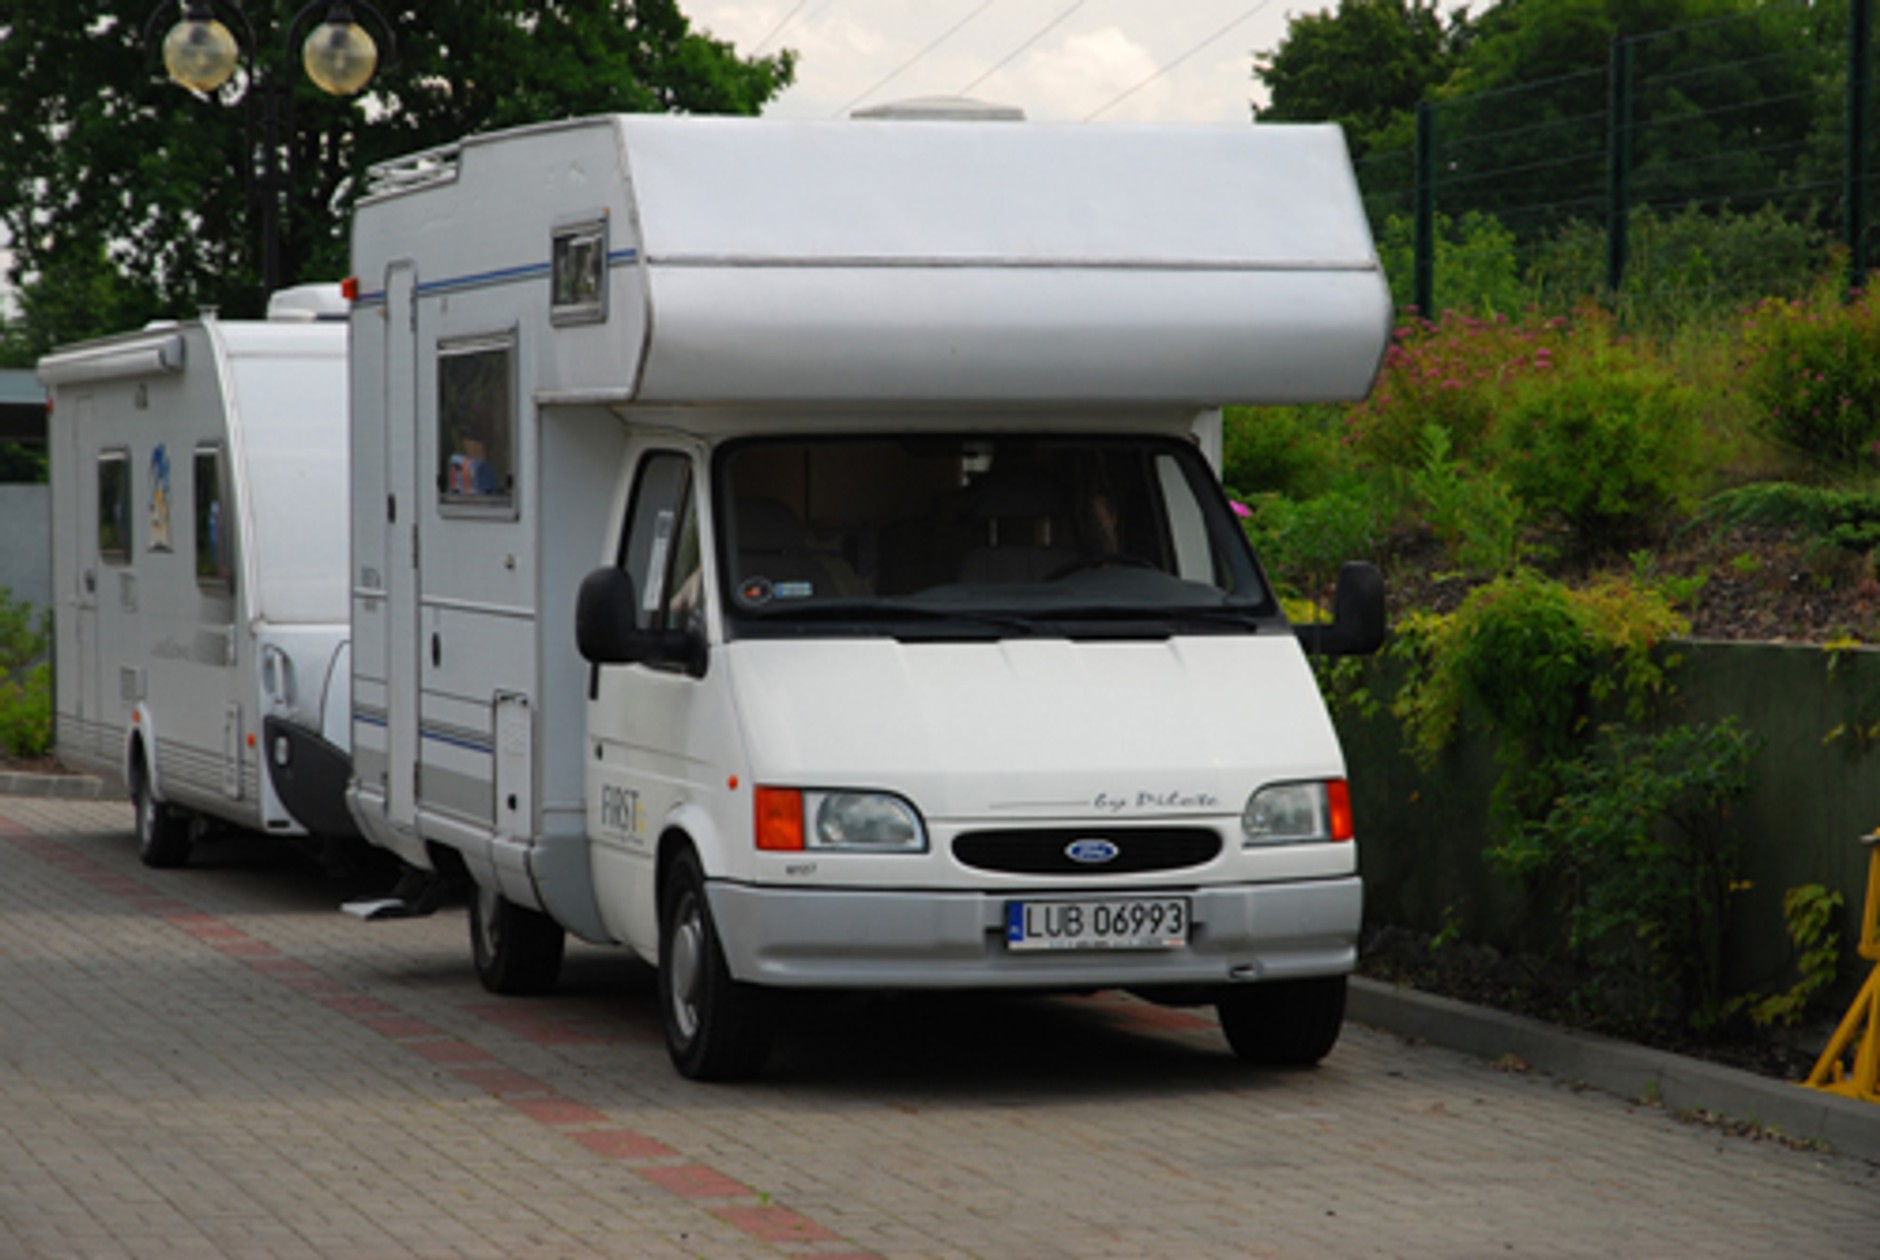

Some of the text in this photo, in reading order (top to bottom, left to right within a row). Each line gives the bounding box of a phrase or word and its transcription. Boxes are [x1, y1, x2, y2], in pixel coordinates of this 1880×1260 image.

[601, 783, 640, 833] FIRST
[1026, 903, 1183, 938] LUB 06993
